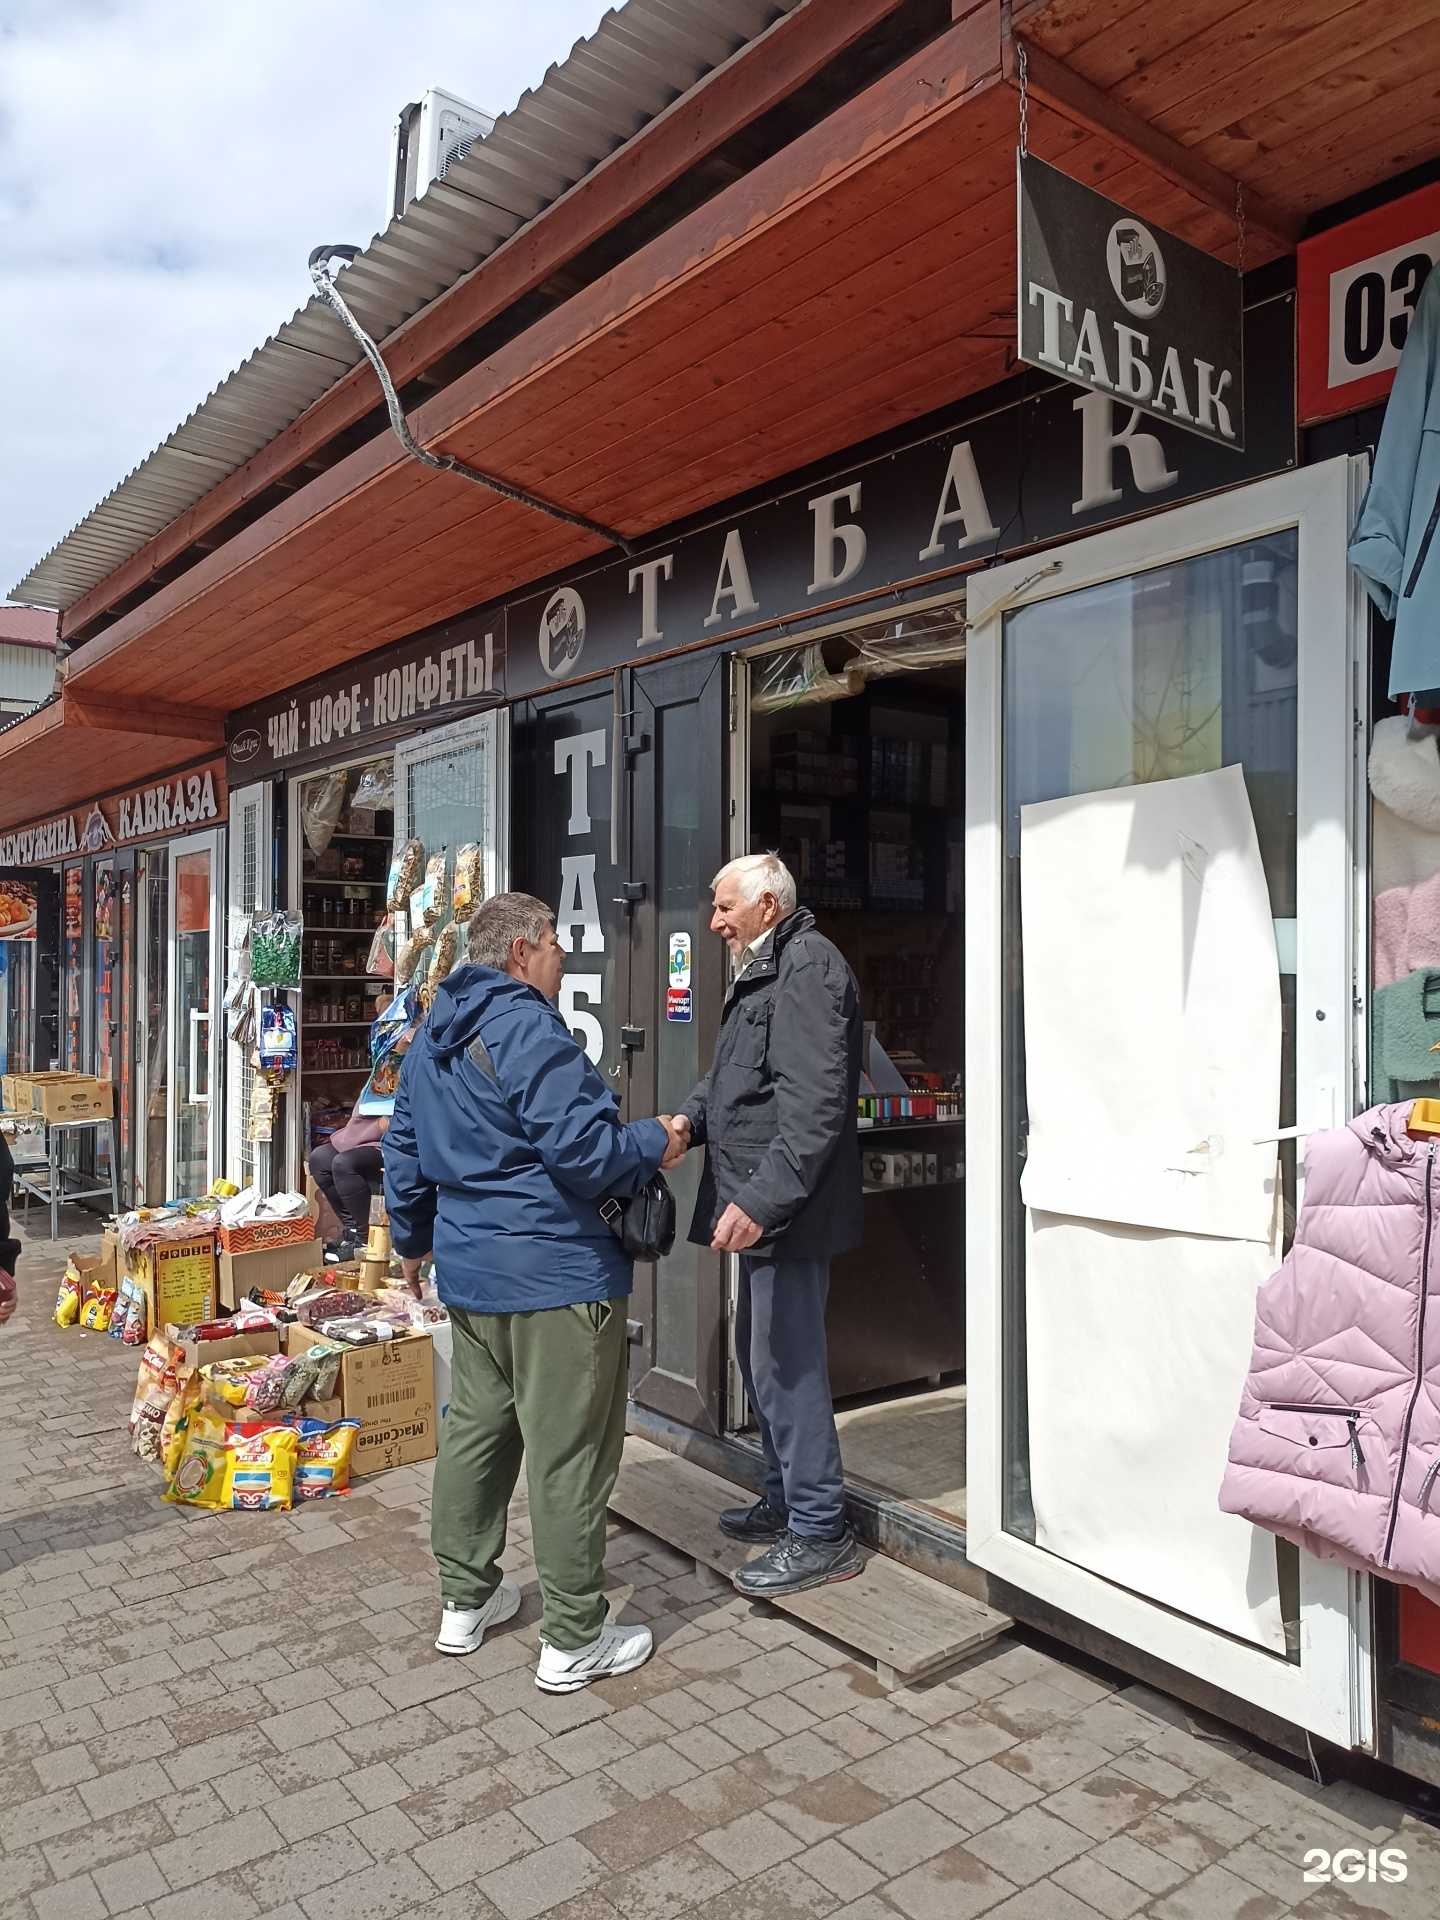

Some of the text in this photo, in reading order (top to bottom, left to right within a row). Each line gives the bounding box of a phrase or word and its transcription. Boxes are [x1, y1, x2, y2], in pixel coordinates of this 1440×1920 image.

[1028, 282, 1236, 439] ТАБАК
[628, 392, 1178, 647] ТАБАК
[268, 633, 493, 758] ЧАЙ КОФЕ КОНФЕТЫ
[118, 770, 218, 840] КАВКАЗА
[359, 1422, 425, 1447] MacCoffee
